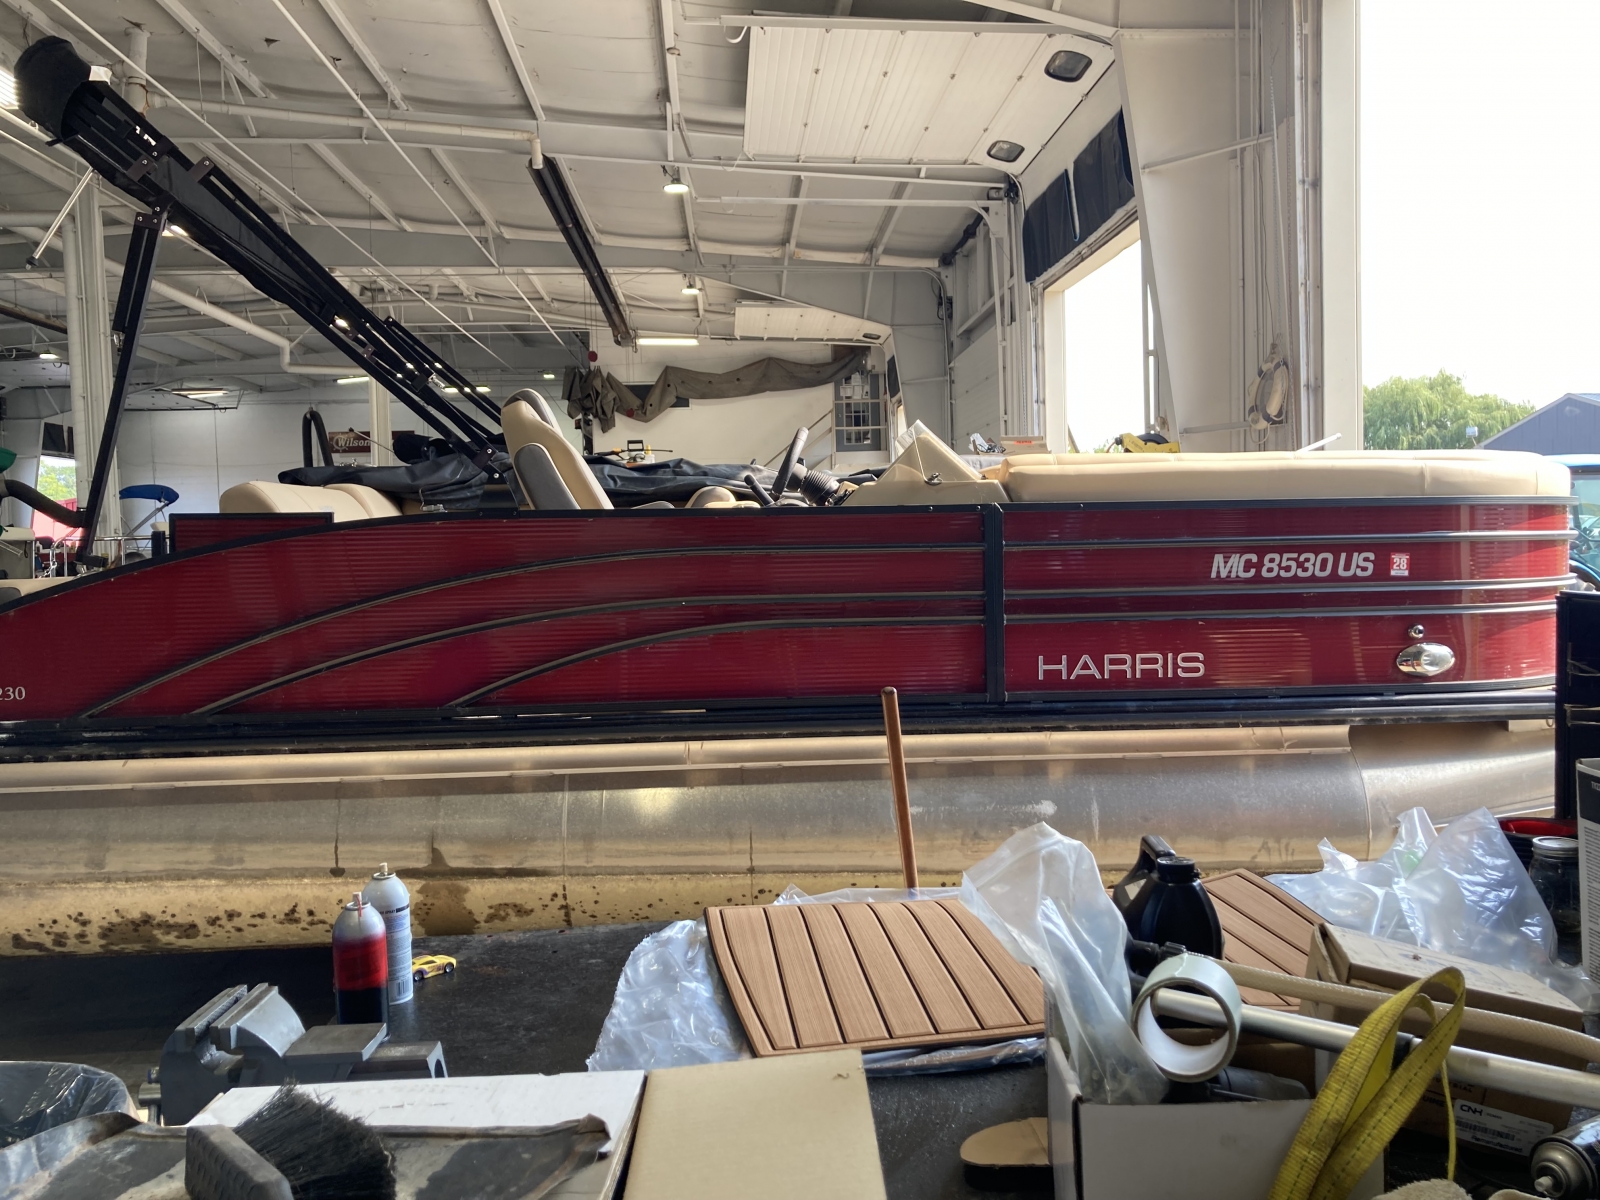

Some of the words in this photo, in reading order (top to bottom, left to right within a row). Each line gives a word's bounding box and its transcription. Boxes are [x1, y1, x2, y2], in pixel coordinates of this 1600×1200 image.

[338, 437, 370, 447] Wilson
[1210, 553, 1257, 579] MC
[1261, 552, 1334, 578] 8530
[1338, 552, 1375, 577] US
[1393, 557, 1407, 570] 28
[1038, 652, 1205, 681] HARRIS
[1460, 1104, 1483, 1117] CNH
